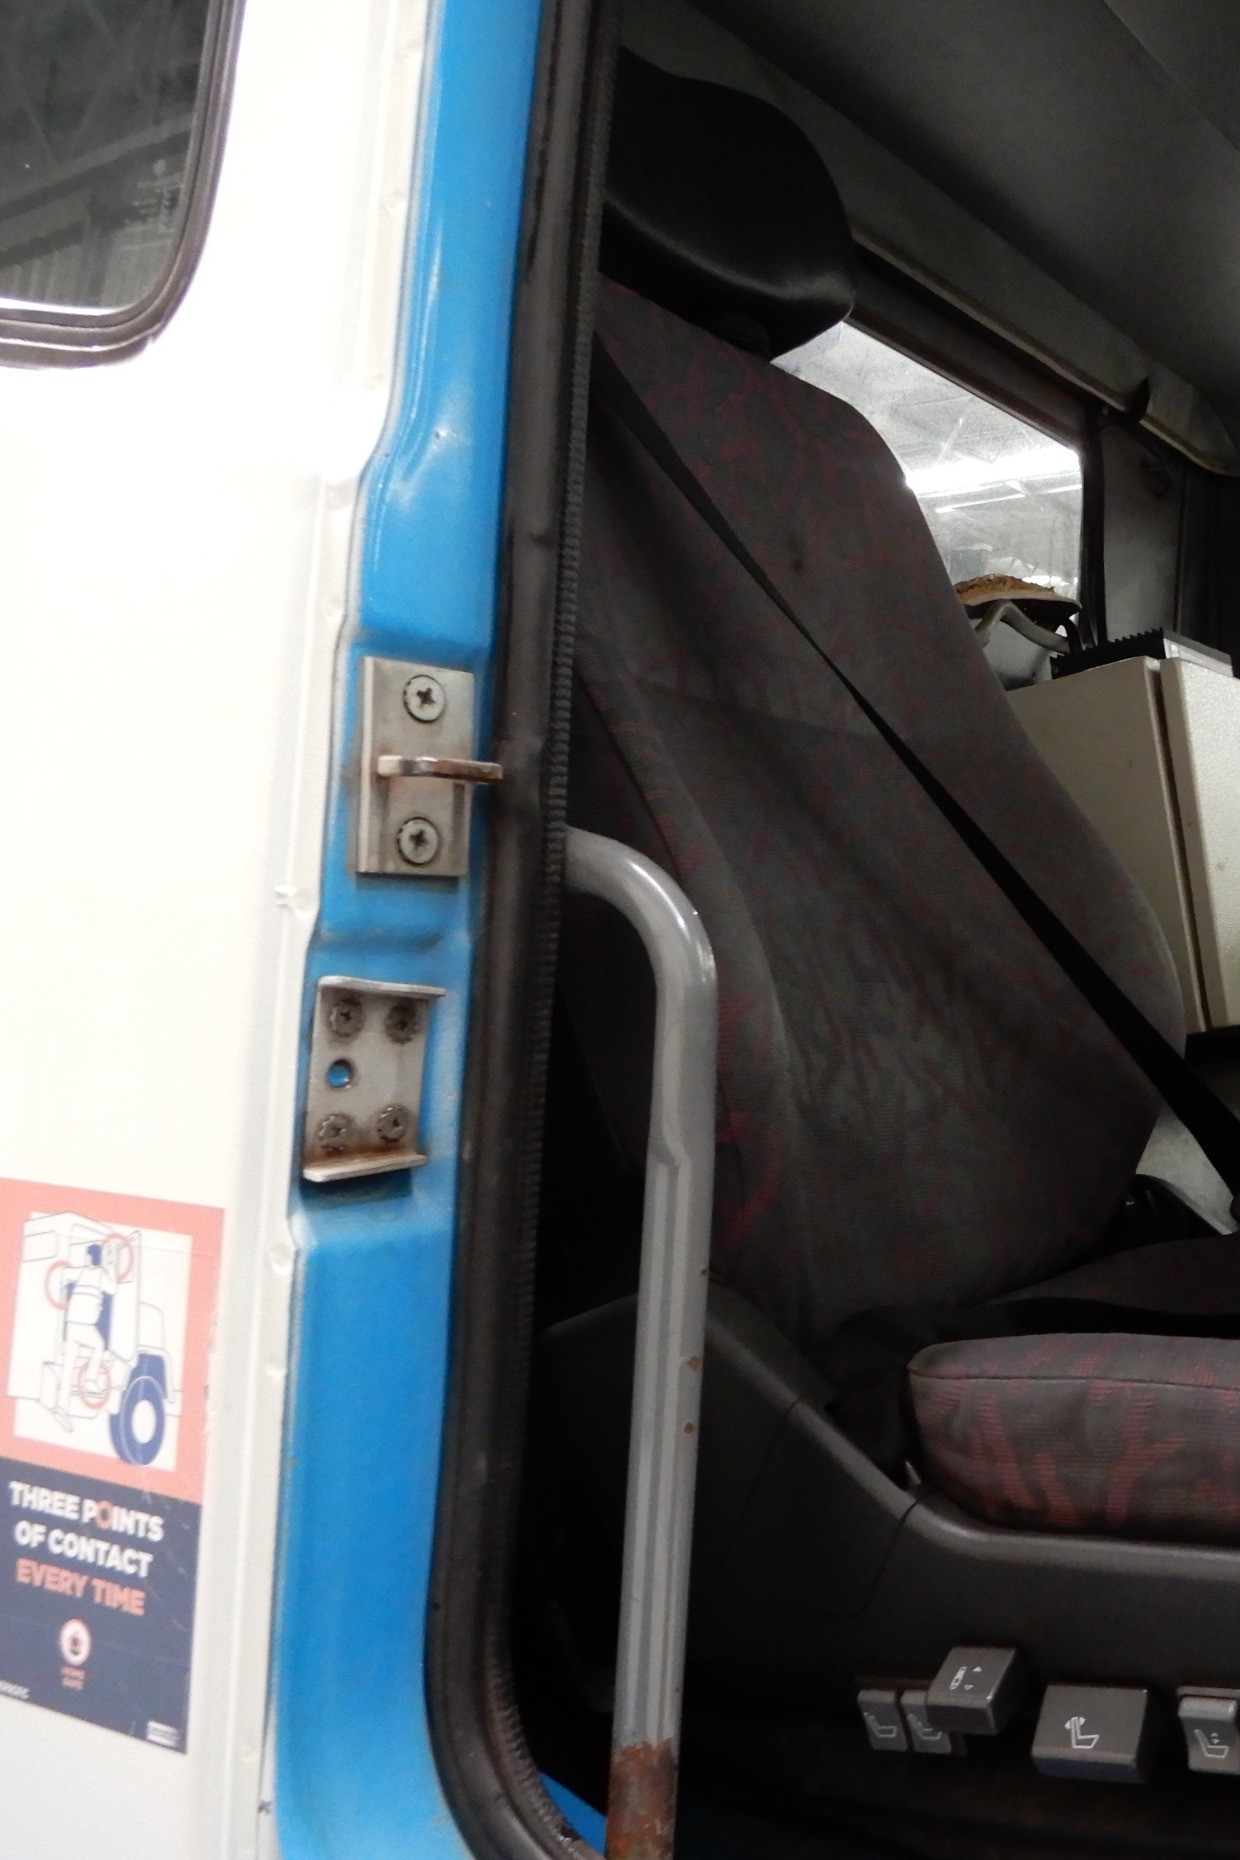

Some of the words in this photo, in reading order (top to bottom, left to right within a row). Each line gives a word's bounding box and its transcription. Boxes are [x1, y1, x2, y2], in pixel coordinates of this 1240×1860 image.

[9, 1480, 81, 1521] THREE
[82, 1498, 165, 1542] POINTS
[14, 1520, 47, 1547] OF
[47, 1529, 154, 1578] CONTACT
[16, 1557, 89, 1598] EVERY
[91, 1578, 146, 1616] TIME
